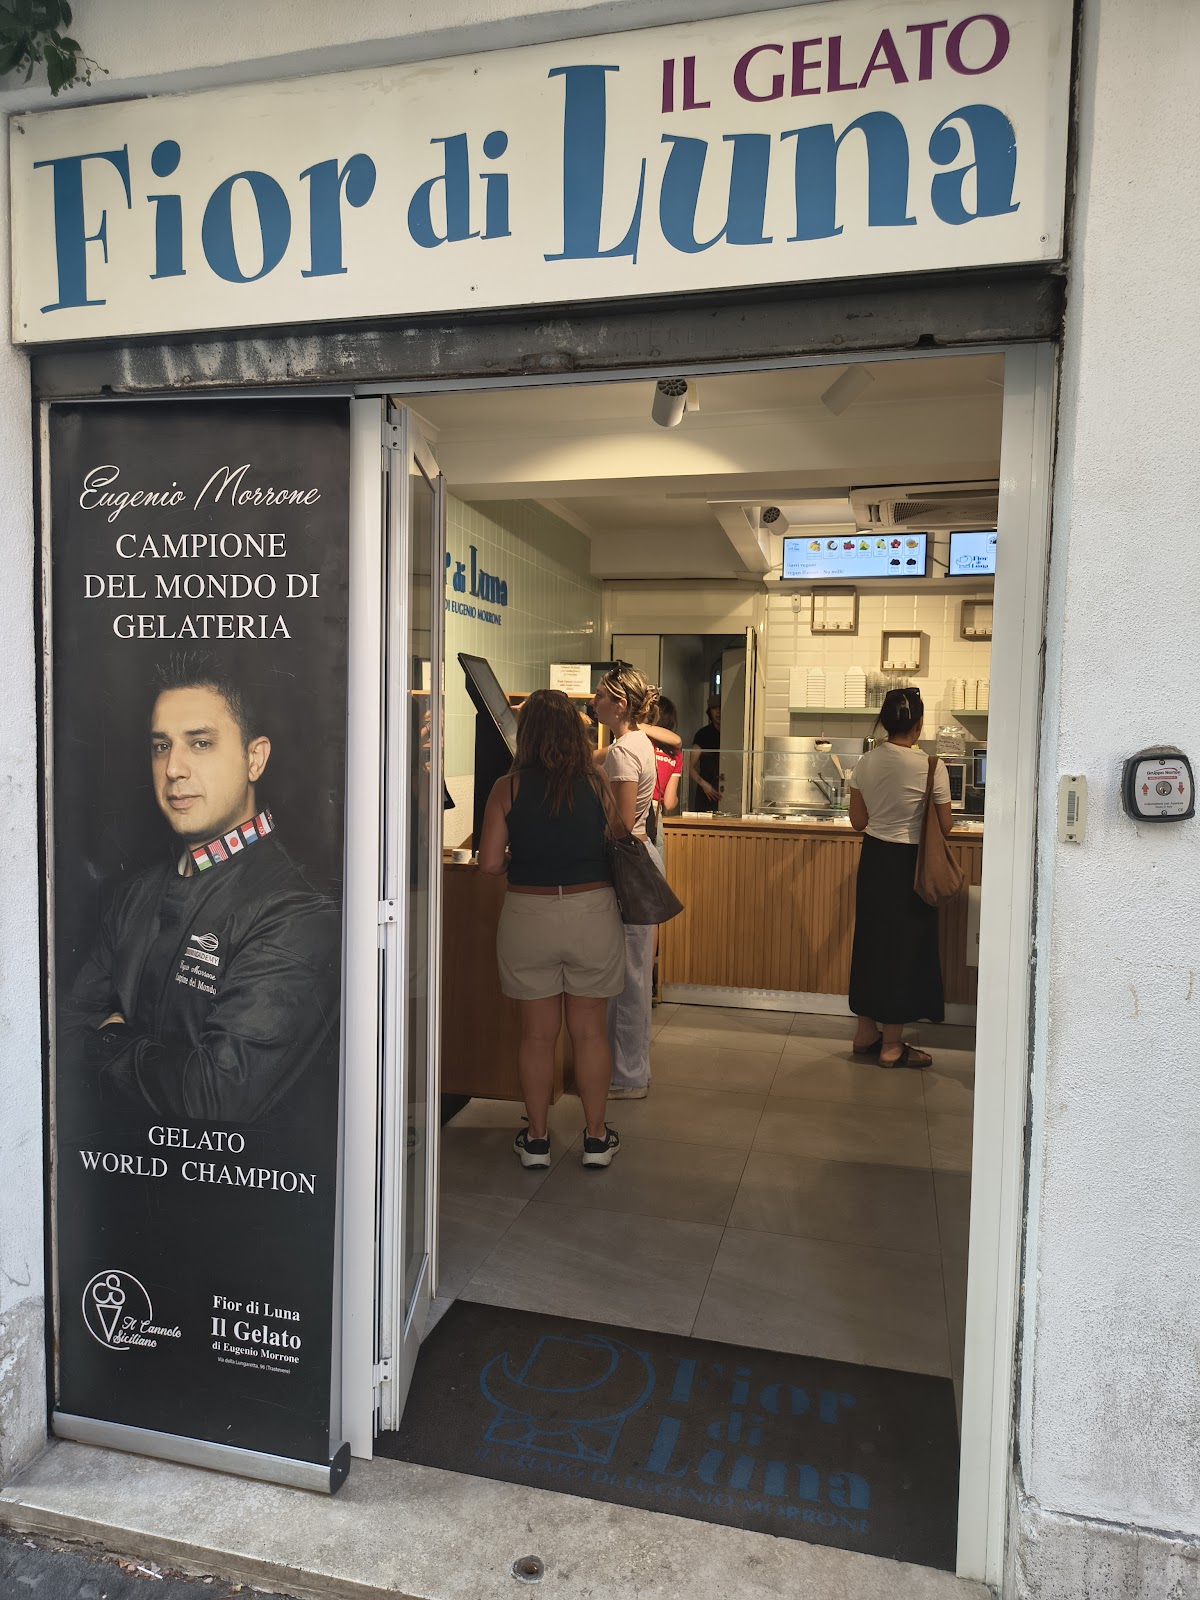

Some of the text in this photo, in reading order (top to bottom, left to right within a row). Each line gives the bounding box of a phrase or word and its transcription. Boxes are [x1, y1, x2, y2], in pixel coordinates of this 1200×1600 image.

[661, 15, 1010, 113] IL GELATO
[34, 65, 1020, 314] Fior di Luna
[80, 464, 321, 522] Eugenio Morrone
[115, 533, 287, 558] CAMPIONE
[84, 573, 320, 598] DEL MONDO DI
[468, 545, 508, 606] Luna
[113, 614, 291, 639] GELATERIA
[452, 600, 476, 618] EUGENIO
[477, 609, 502, 625] MORRONE
[148, 1126, 245, 1154] GELATO
[79, 1151, 317, 1195] WORLD CHAMPION
[213, 1295, 300, 1321] Fior di Luna
[112, 1330, 157, 1347] Siciliano
[140, 1320, 181, 1338] Cannolo
[211, 1317, 302, 1349] Il Gelato
[212, 1341, 300, 1363] di Eugenio Morrone
[667, 1357, 857, 1425] Fior
[706, 1411, 763, 1447] di
[635, 1414, 871, 1512] Luna
[742, 1498, 870, 1534] MORRONE
